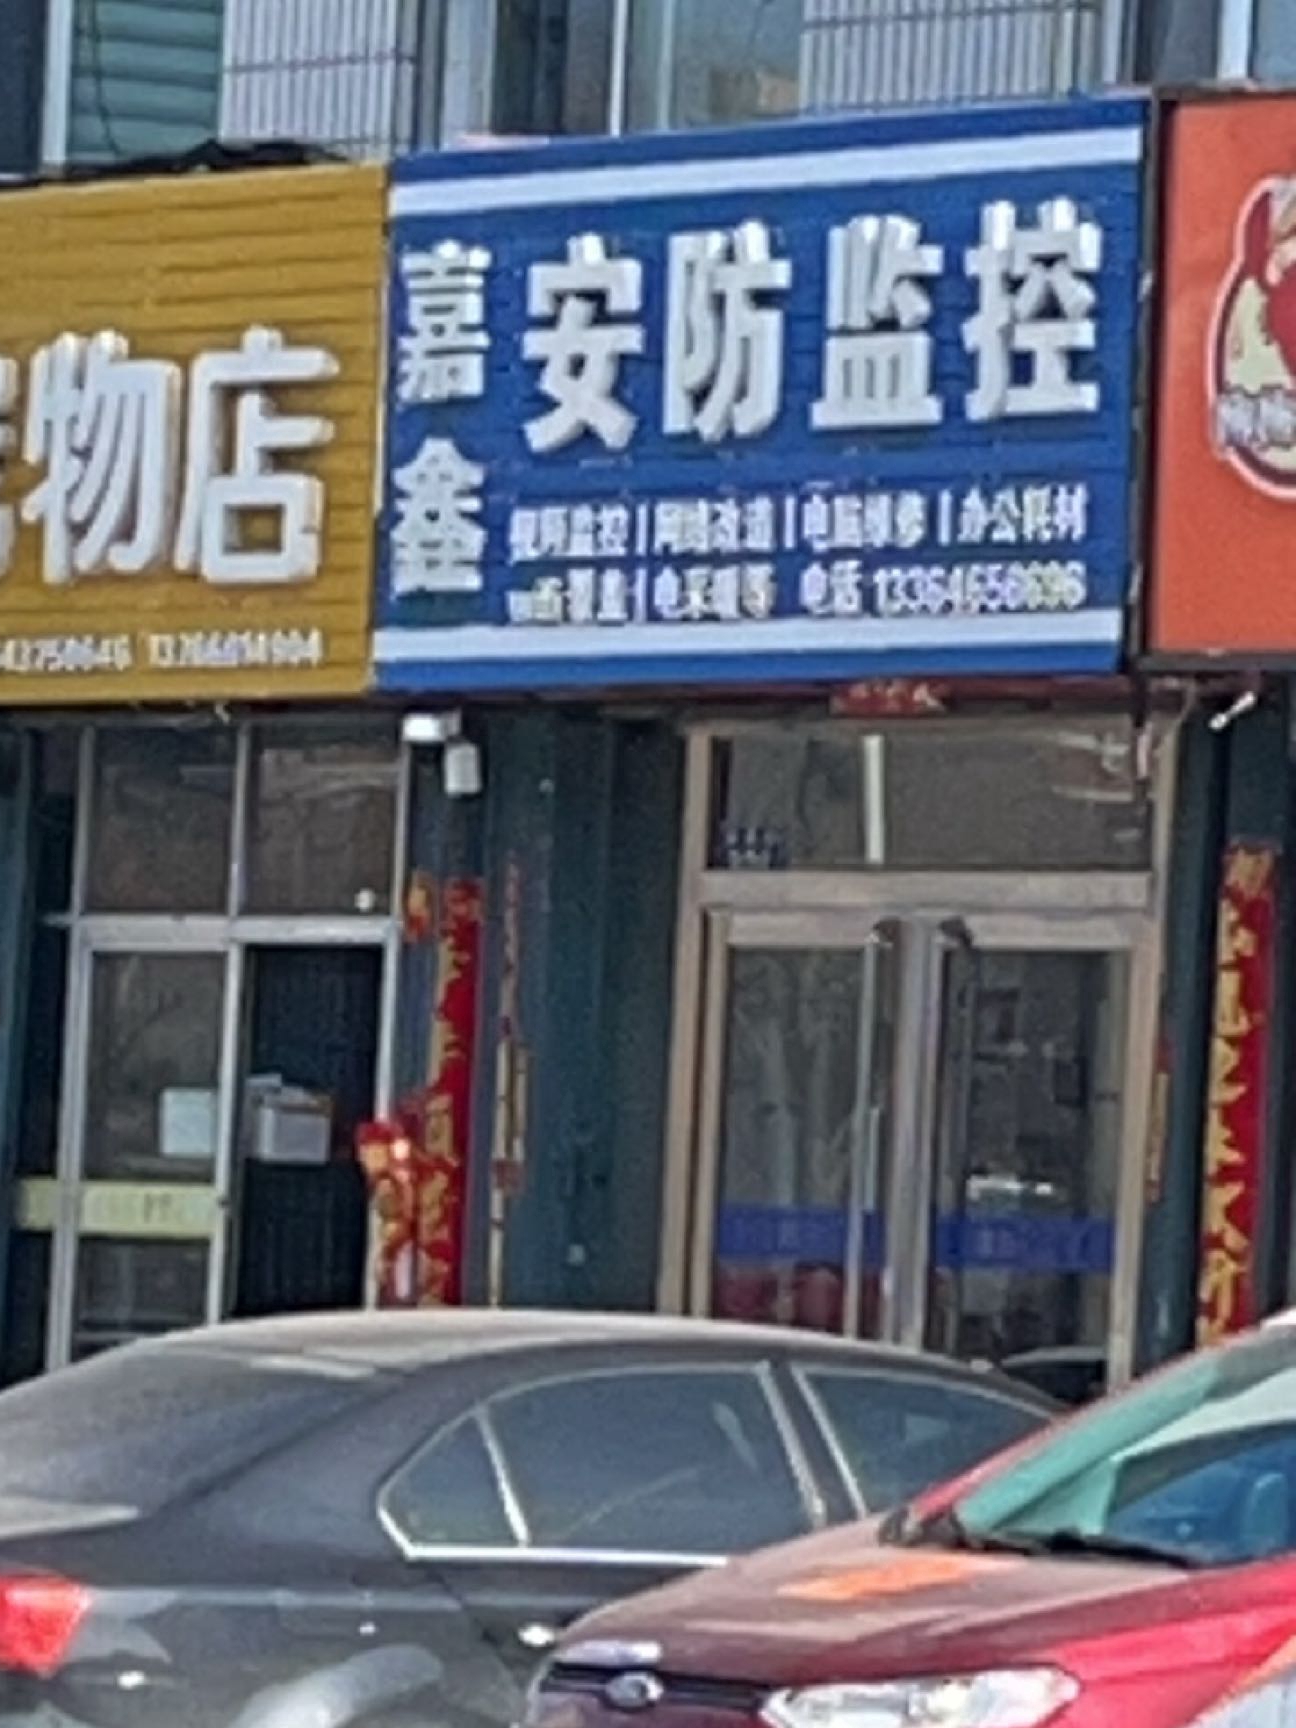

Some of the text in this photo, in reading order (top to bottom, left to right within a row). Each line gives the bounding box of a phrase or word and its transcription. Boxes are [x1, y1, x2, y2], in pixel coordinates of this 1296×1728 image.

[391, 238, 492, 595] 嘉鑫
[522, 195, 1103, 454] 安防监控
